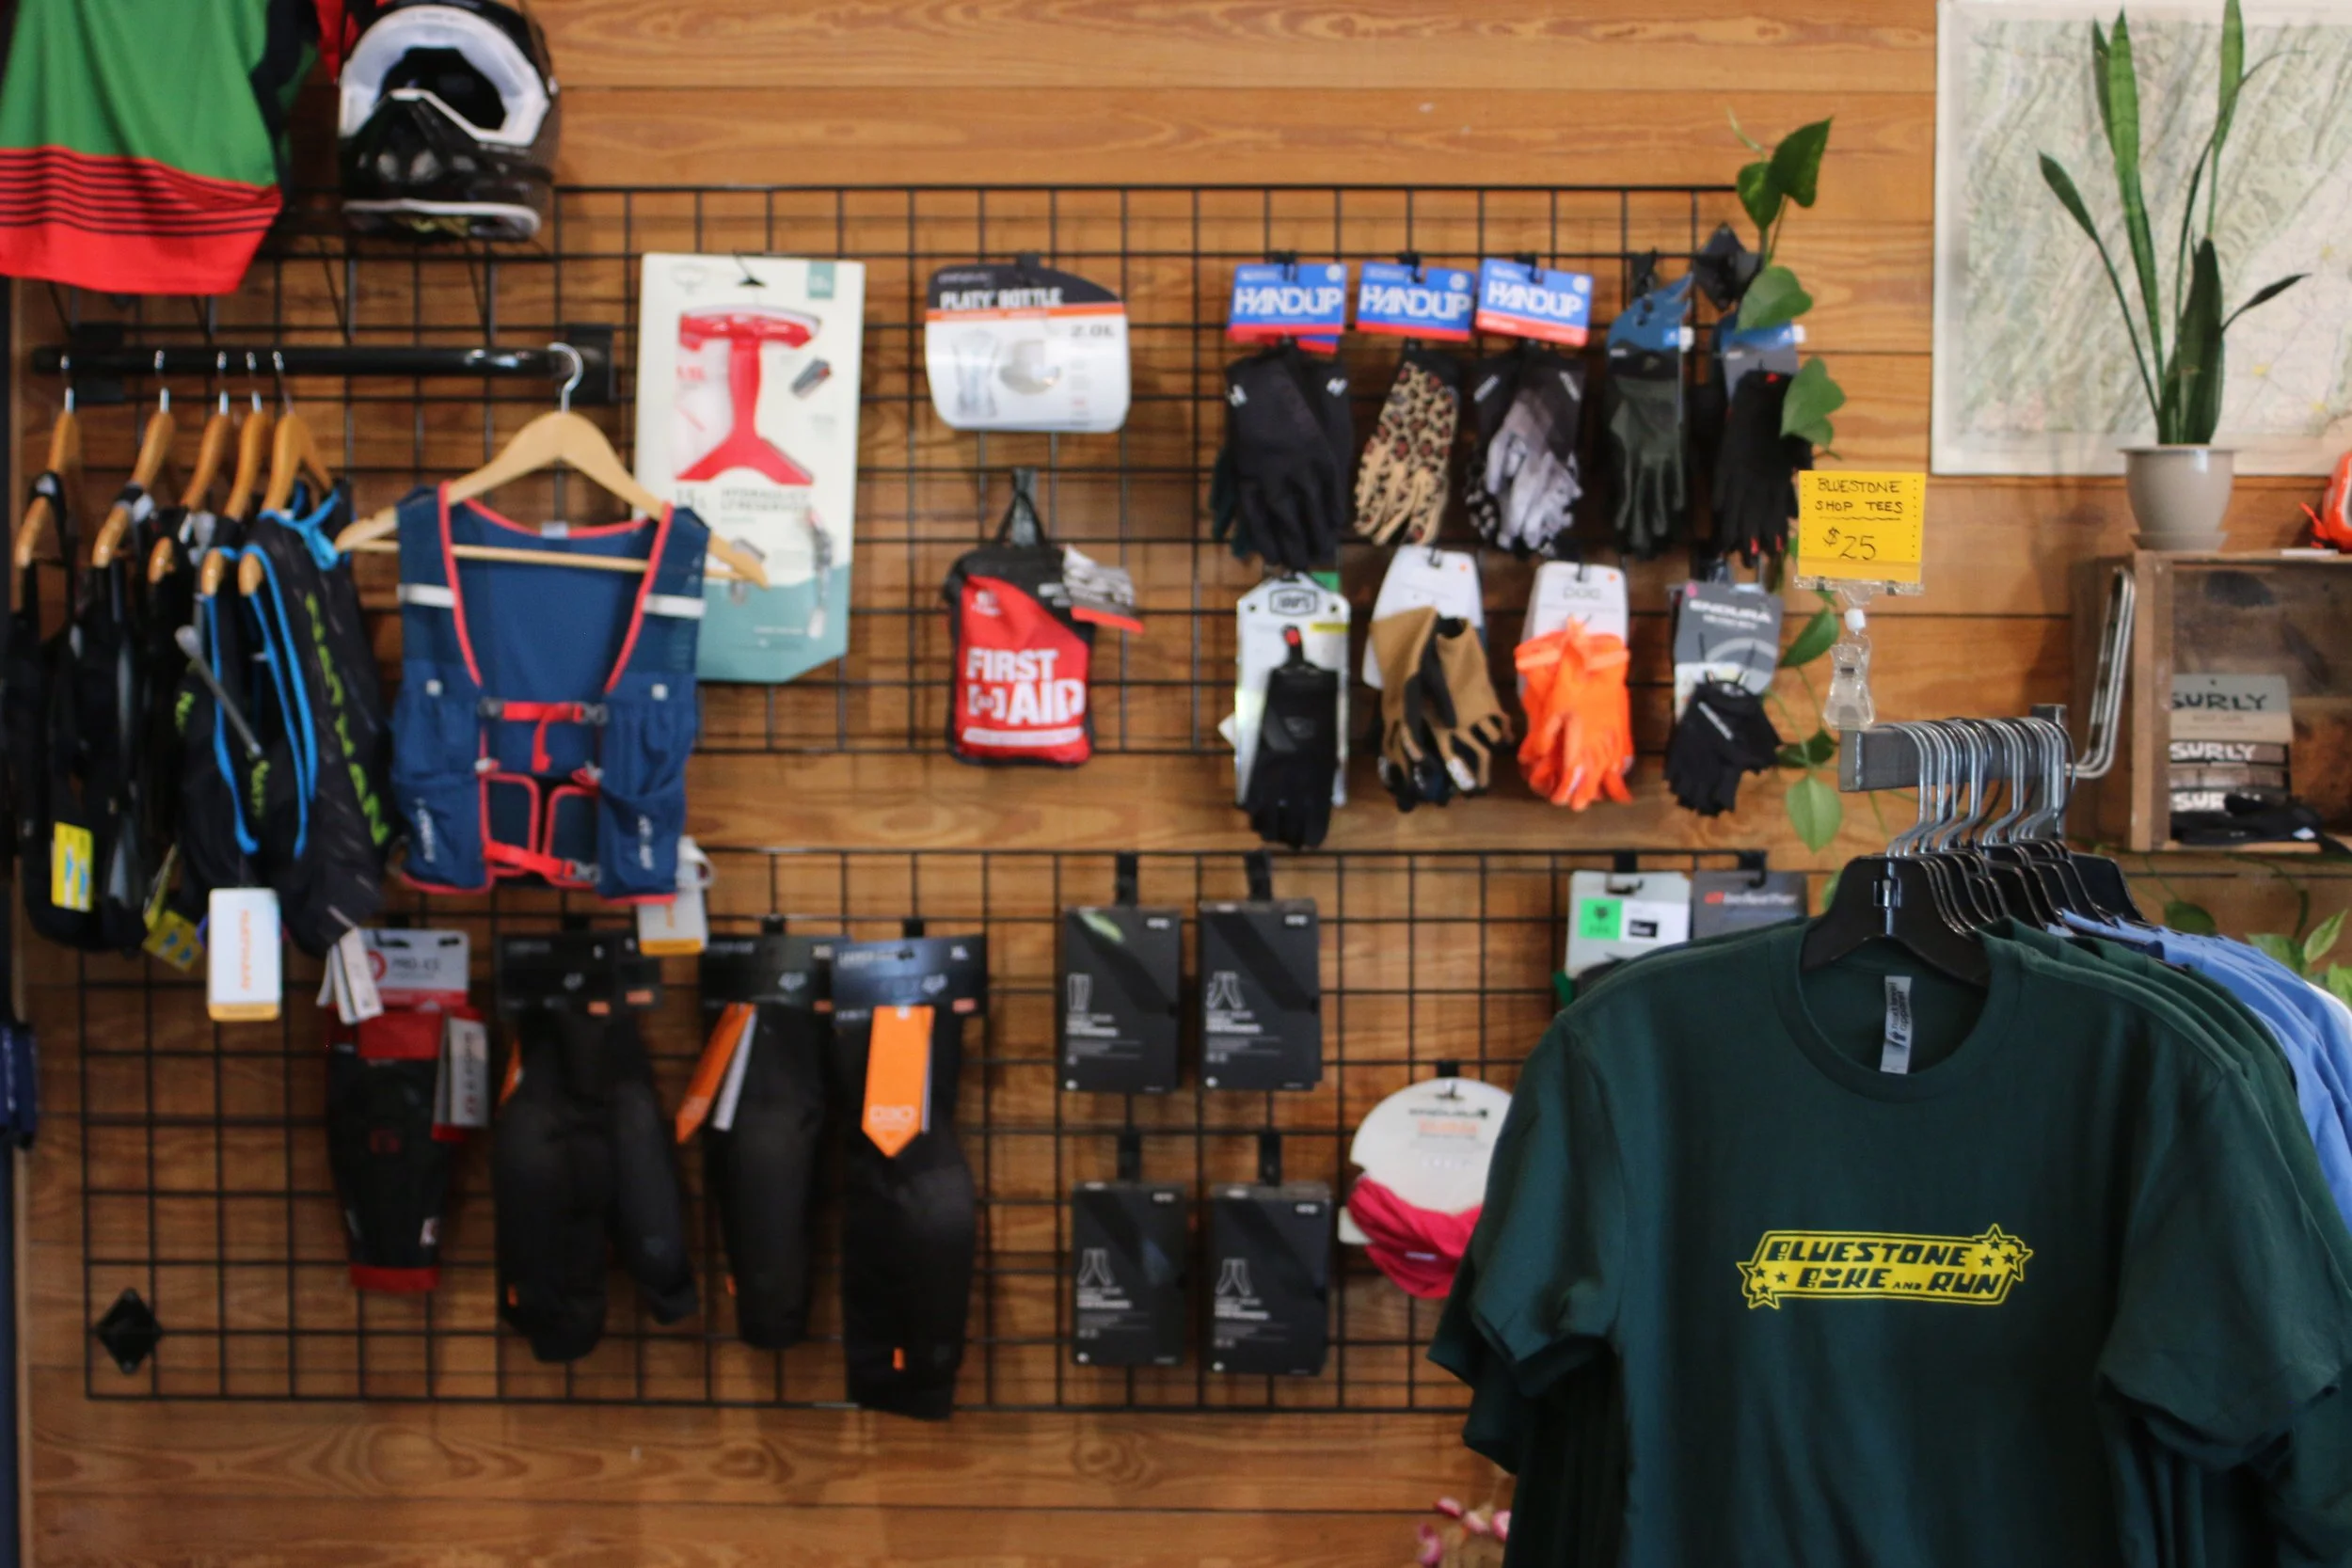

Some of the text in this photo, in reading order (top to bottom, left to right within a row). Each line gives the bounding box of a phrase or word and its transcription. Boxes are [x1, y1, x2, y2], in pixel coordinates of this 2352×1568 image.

[1232, 286, 1343, 316] HANDUP
[1359, 283, 1472, 321] HANDUP
[1486, 279, 1584, 318] HANDUP
[1817, 477, 1903, 494] BLUESTONE
[1815, 499, 1903, 514] SHOP TEES
[1822, 527, 1876, 561] $25
[967, 647, 1058, 683] FIRST
[1007, 678, 1087, 726] AID
[2171, 691, 2266, 711] SURLY
[2169, 741, 2257, 762] SURLY
[1766, 1240, 1973, 1267] BLUESTONE
[1892, 1280, 1923, 1292] AND
[1926, 1271, 2002, 1295] RUN
